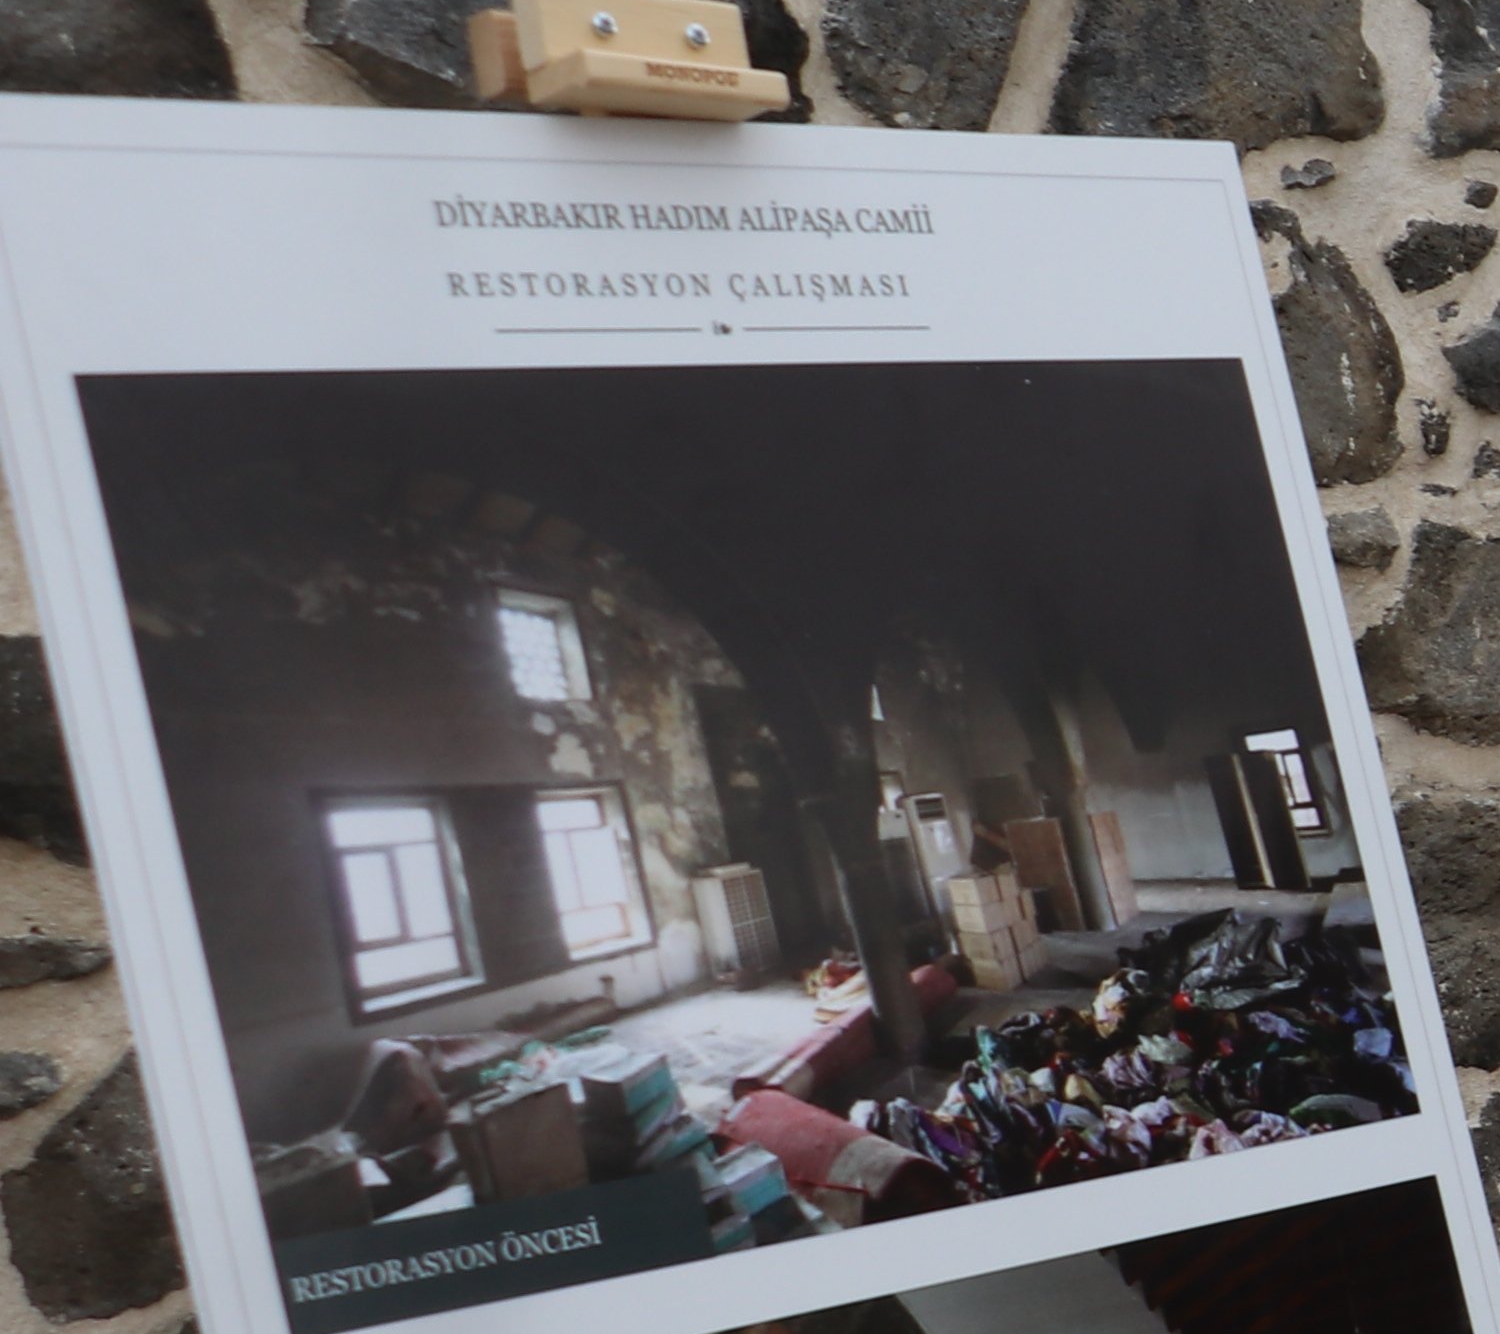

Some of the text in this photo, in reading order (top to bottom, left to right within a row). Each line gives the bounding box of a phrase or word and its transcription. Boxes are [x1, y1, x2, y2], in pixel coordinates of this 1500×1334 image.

[434, 194, 936, 240] DİYARBAKIR HADIM ALİPAŞA CAMİİ
[447, 271, 911, 302] RESTORASYON ÇALIŞMASI
[290, 1215, 602, 1303] RESTORASYON ÖNCESİ
